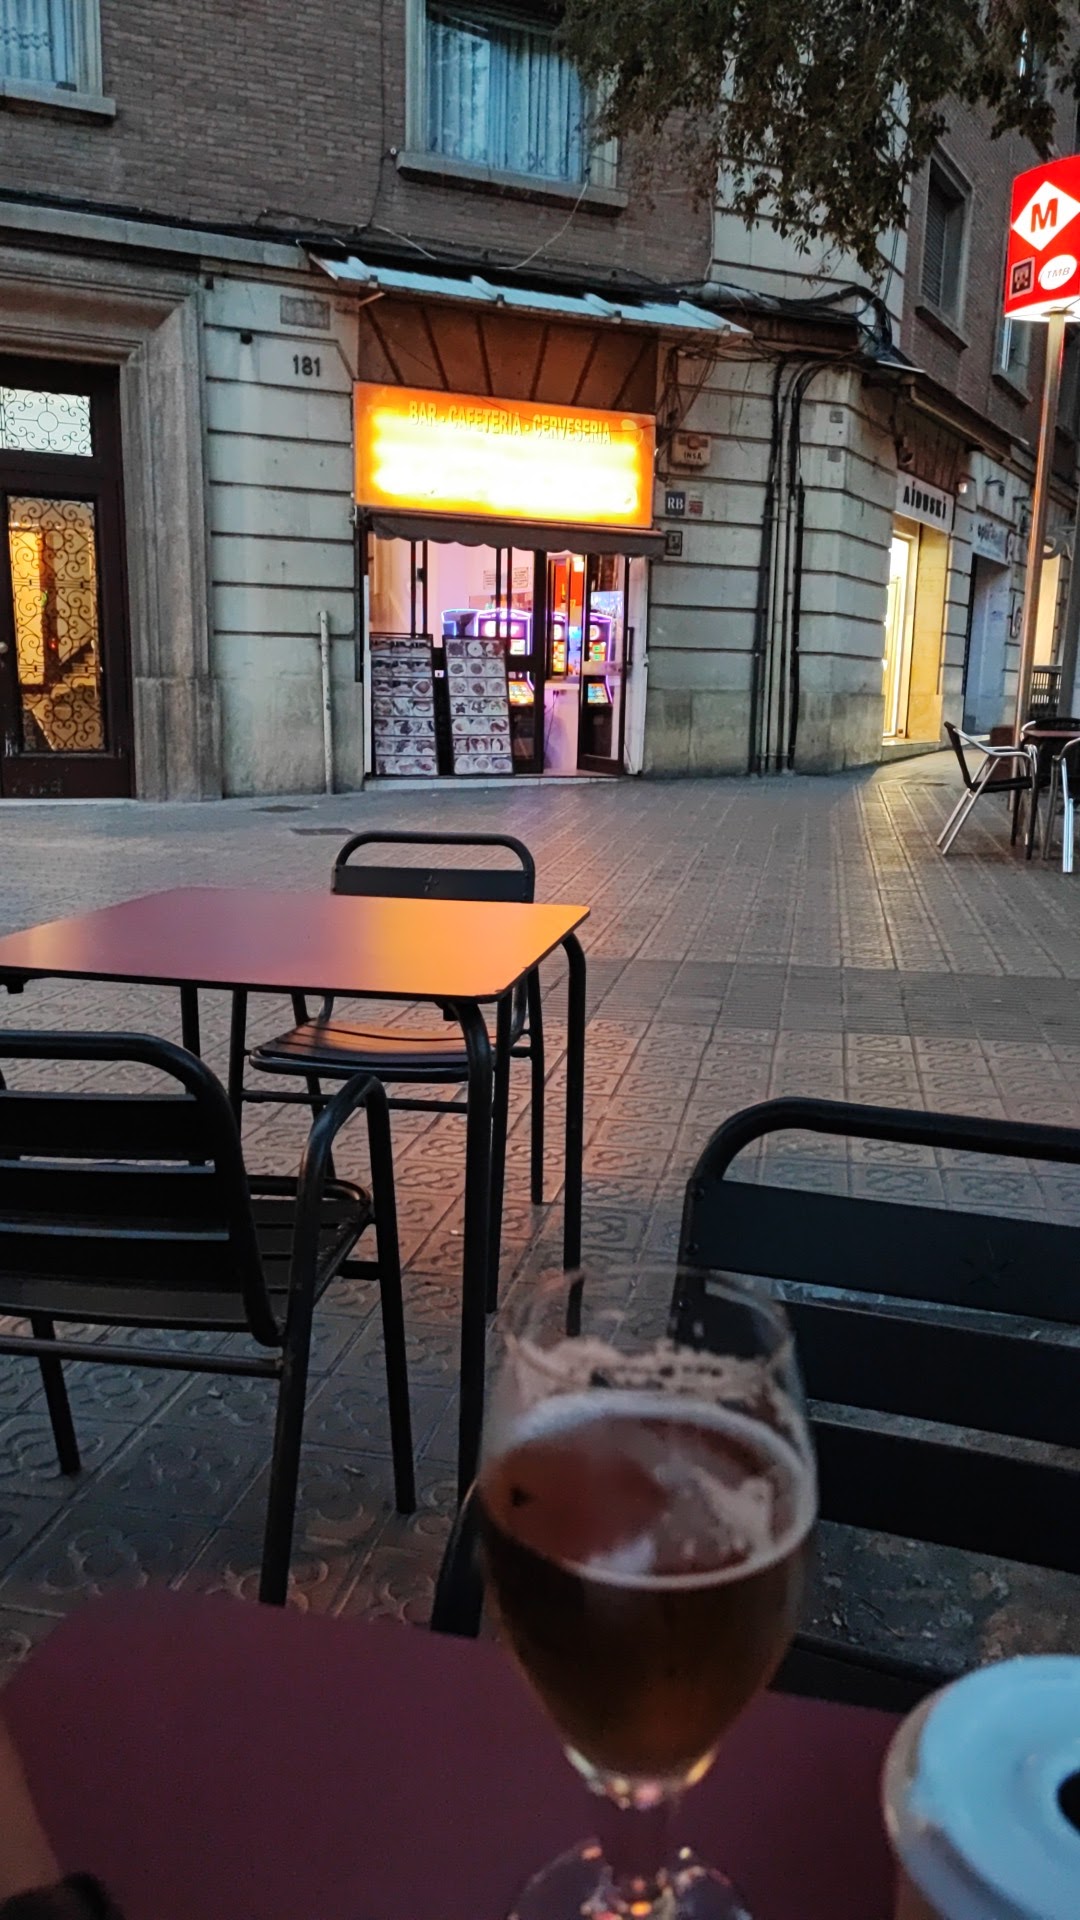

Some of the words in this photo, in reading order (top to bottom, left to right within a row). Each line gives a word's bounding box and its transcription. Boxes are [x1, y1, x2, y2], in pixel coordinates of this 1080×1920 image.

[1030, 197, 1058, 233] M
[1047, 266, 1071, 279] TMB
[292, 353, 321, 377] 181
[409, 400, 438, 426] BAR
[532, 414, 612, 445] CERVESERIA
[667, 497, 684, 510] RB
